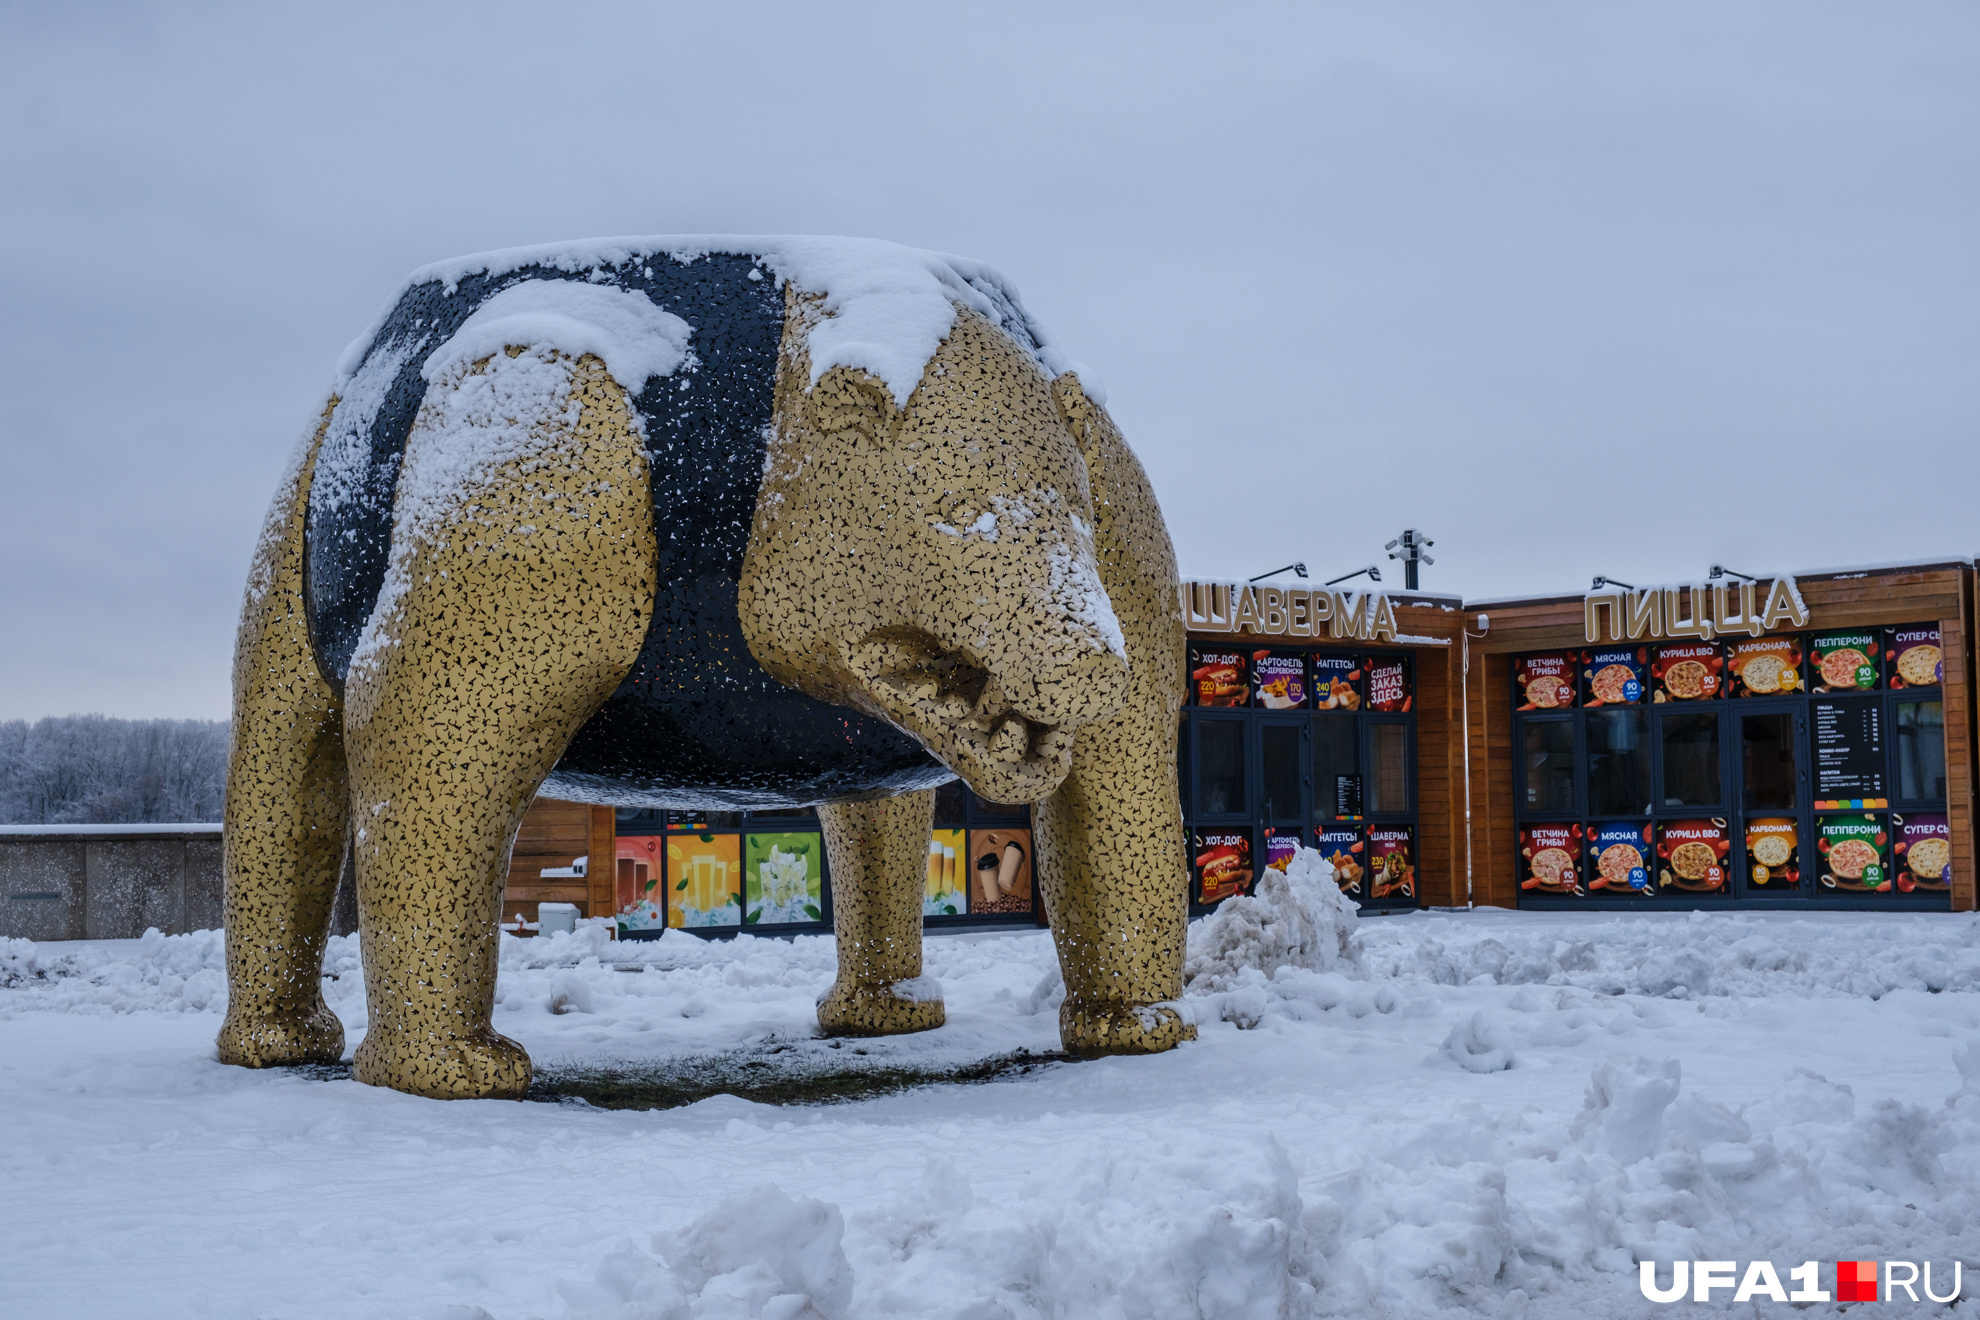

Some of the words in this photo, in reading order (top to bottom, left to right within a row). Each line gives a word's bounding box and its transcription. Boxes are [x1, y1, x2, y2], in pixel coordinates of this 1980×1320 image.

[1182, 582, 1397, 642] ШАВЕРМА
[1584, 579, 1809, 642] ПИЦЦА
[1814, 636, 1872, 647] ПЕППЕРОНИ
[1896, 632, 1927, 642] СУПЕР
[1738, 641, 1791, 653] КАРБОНАРА
[1660, 648, 1695, 658] КУРИЦА
[1696, 647, 1713, 656] BBQ
[1202, 654, 1239, 665] ХОТ-ДОГ
[1595, 653, 1631, 663] МЯСНАЯ
[1257, 658, 1303, 668] КАРТОФЕЛЬ
[1317, 660, 1355, 669] НАГГЕТСЫ
[1528, 658, 1564, 668] ВЕТЧИНА
[1257, 666, 1304, 675] ПО-ДЕРЕВЕНСКИ
[1371, 663, 1402, 679] СДЕЛАЙ
[1532, 666, 1560, 676] ГРИБЫ
[1783, 670, 1793, 679] 90
[1860, 668, 1871, 676] 90
[1371, 675, 1402, 691] ЗАКАЗ
[1704, 676, 1714, 684] 90
[1200, 682, 1214, 690] 220
[1290, 683, 1301, 692] 170
[1316, 683, 1329, 691] 240
[1371, 688, 1403, 704] ЗДЕСЬ
[1750, 825, 1792, 833] КАРБОНАРА
[1823, 825, 1881, 835] ПЕППЕРОНИ
[1904, 825, 1935, 835] СУПЕР
[1320, 832, 1357, 842] НАГГЕТСЫ
[1371, 832, 1408, 841] ШАВЕРМА
[1532, 830, 1569, 838] ВЕТЧИНА
[1601, 832, 1637, 840] МЯСНАЯ
[1666, 830, 1702, 839] КУРИЦА
[1703, 829, 1720, 838] BBQ
[1206, 836, 1242, 846] ХОТ-ДОГ
[1537, 838, 1565, 846] ГРИБЫ
[1372, 857, 1384, 865] 230
[1564, 871, 1574, 879] 90
[1632, 870, 1643, 878] 90
[1709, 868, 1719, 876] 90
[1867, 867, 1878, 876] 90
[1204, 877, 1217, 886] 220
